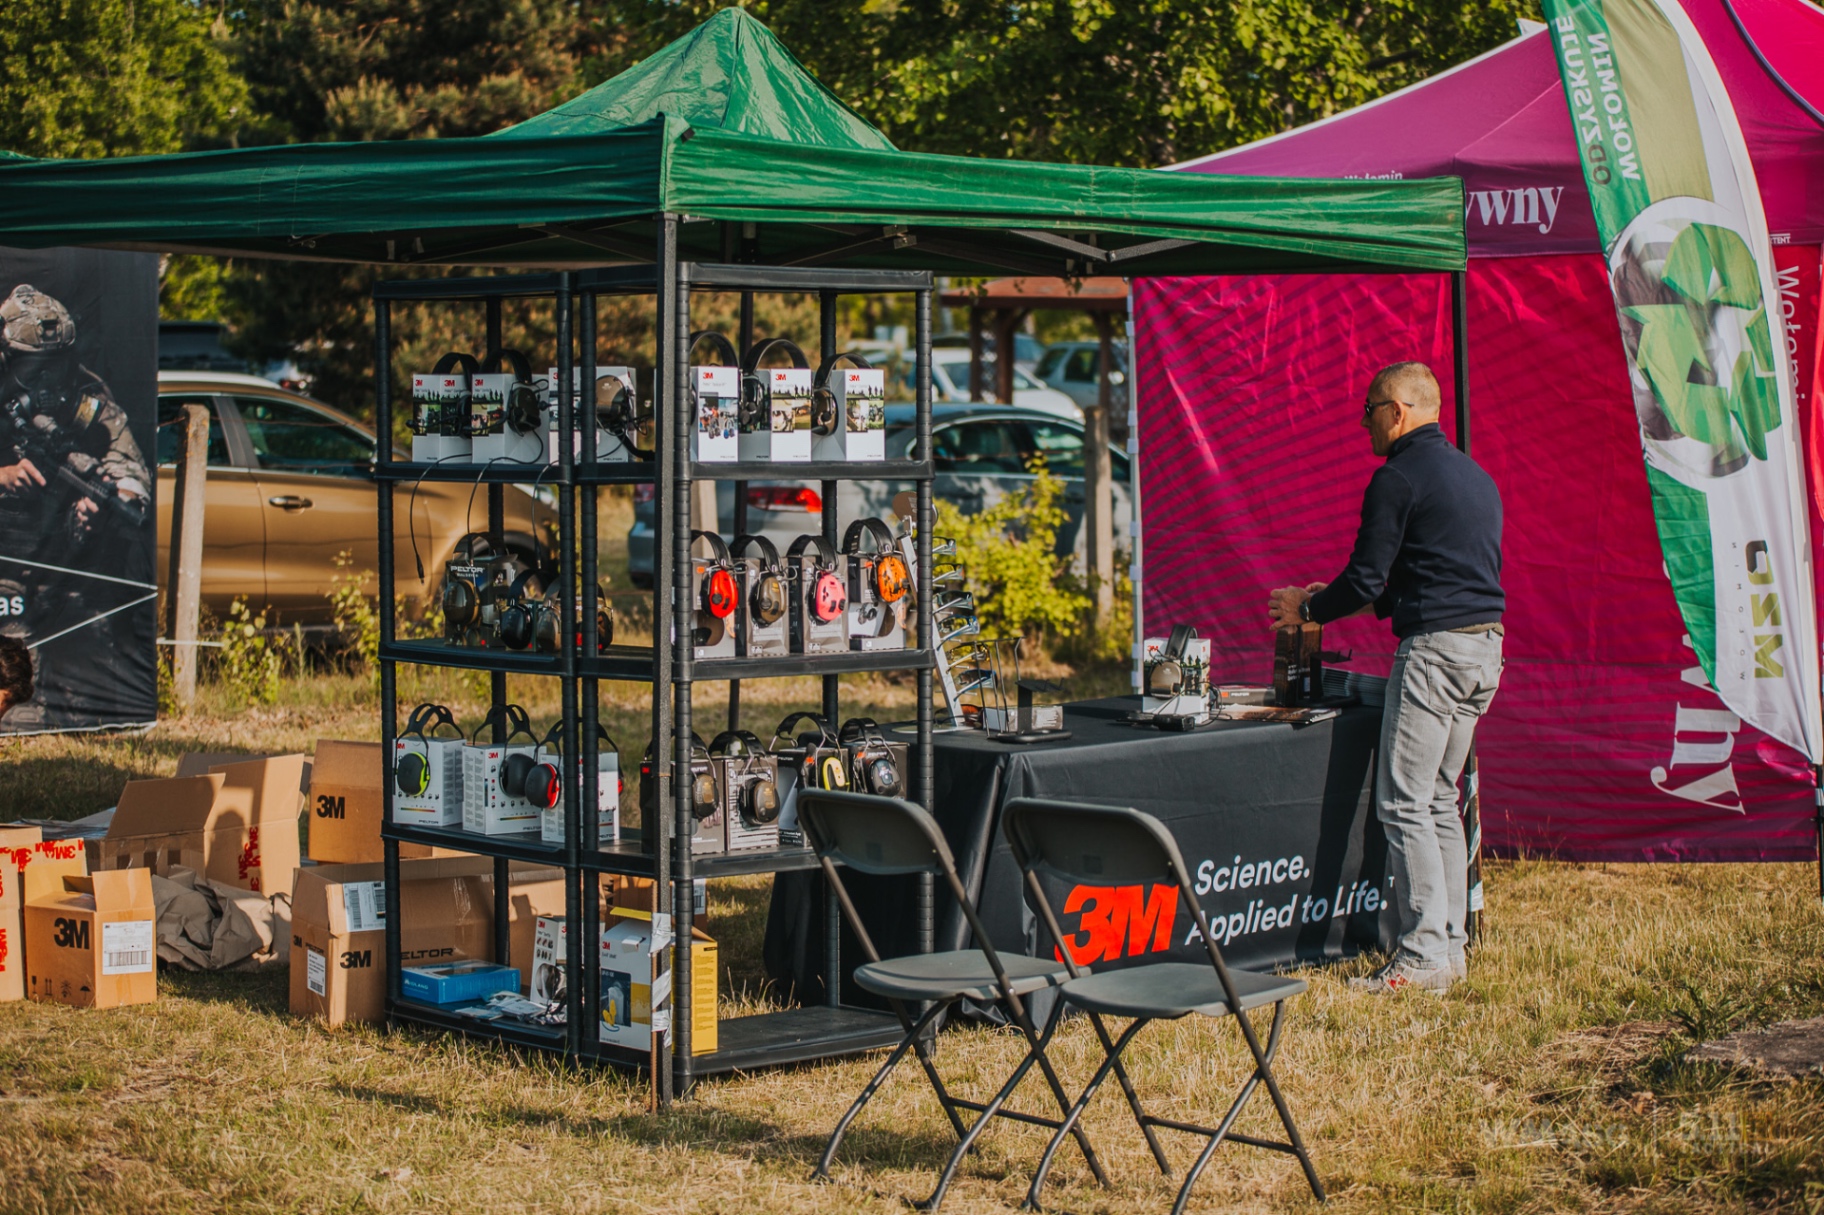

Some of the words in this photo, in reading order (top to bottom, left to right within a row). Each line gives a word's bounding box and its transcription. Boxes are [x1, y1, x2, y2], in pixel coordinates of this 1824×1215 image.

[450, 565, 485, 574] PELTOR
[316, 794, 345, 820] 3M
[56, 845, 76, 859] 3M
[1194, 854, 1310, 896] Science.
[1184, 894, 1296, 946] Applied
[1302, 894, 1328, 923] to
[1332, 880, 1388, 918] Life.
[54, 917, 90, 950] 3M
[1054, 884, 1179, 966] 3M
[293, 935, 302, 948] 3M
[602, 941, 611, 950] 3M
[340, 950, 372, 969] 3M
[400, 948, 455, 960] ELTOR
